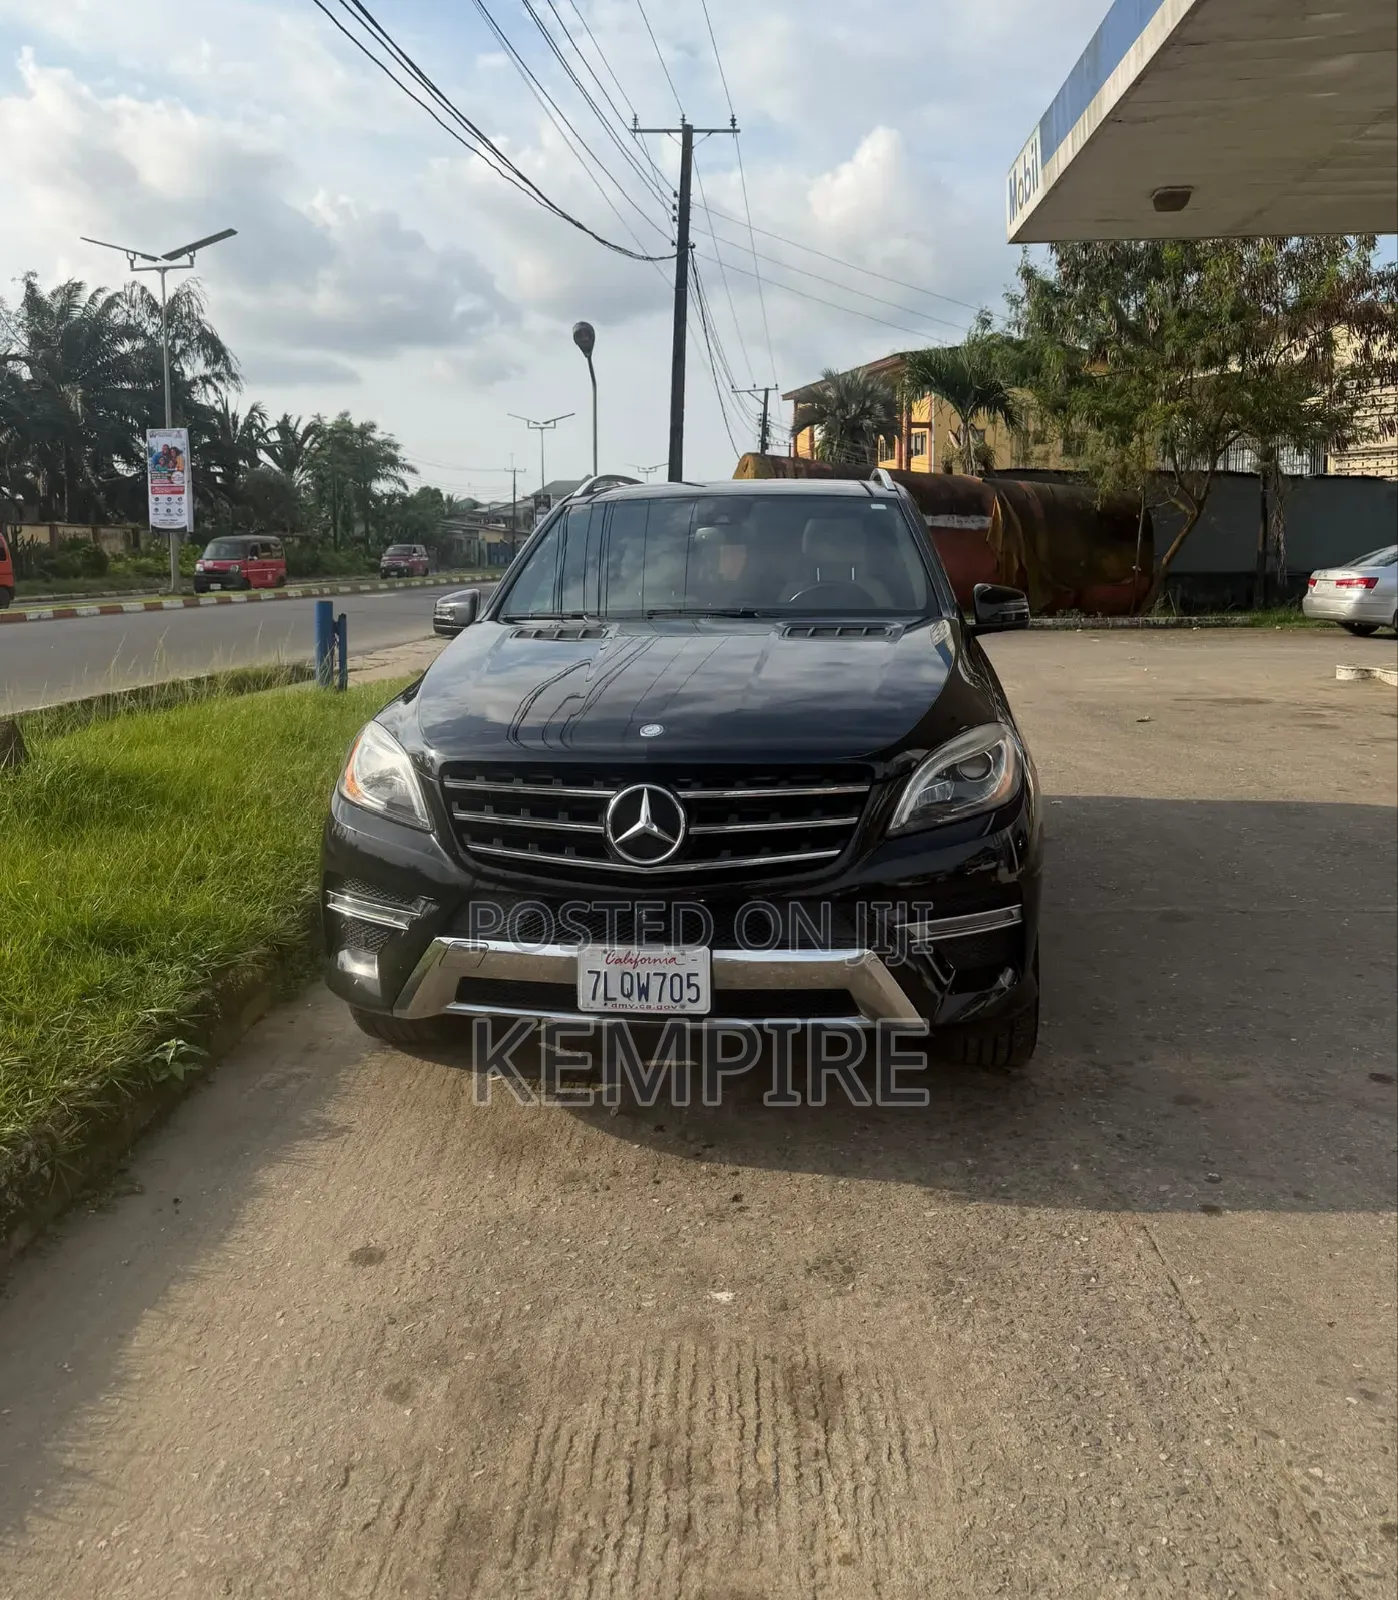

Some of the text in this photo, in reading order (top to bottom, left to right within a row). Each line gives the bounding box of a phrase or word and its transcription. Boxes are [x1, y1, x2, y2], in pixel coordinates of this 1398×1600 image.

[1009, 138, 1038, 225] Mobil
[605, 950, 684, 969] California
[587, 970, 700, 1004] 7LQW705
